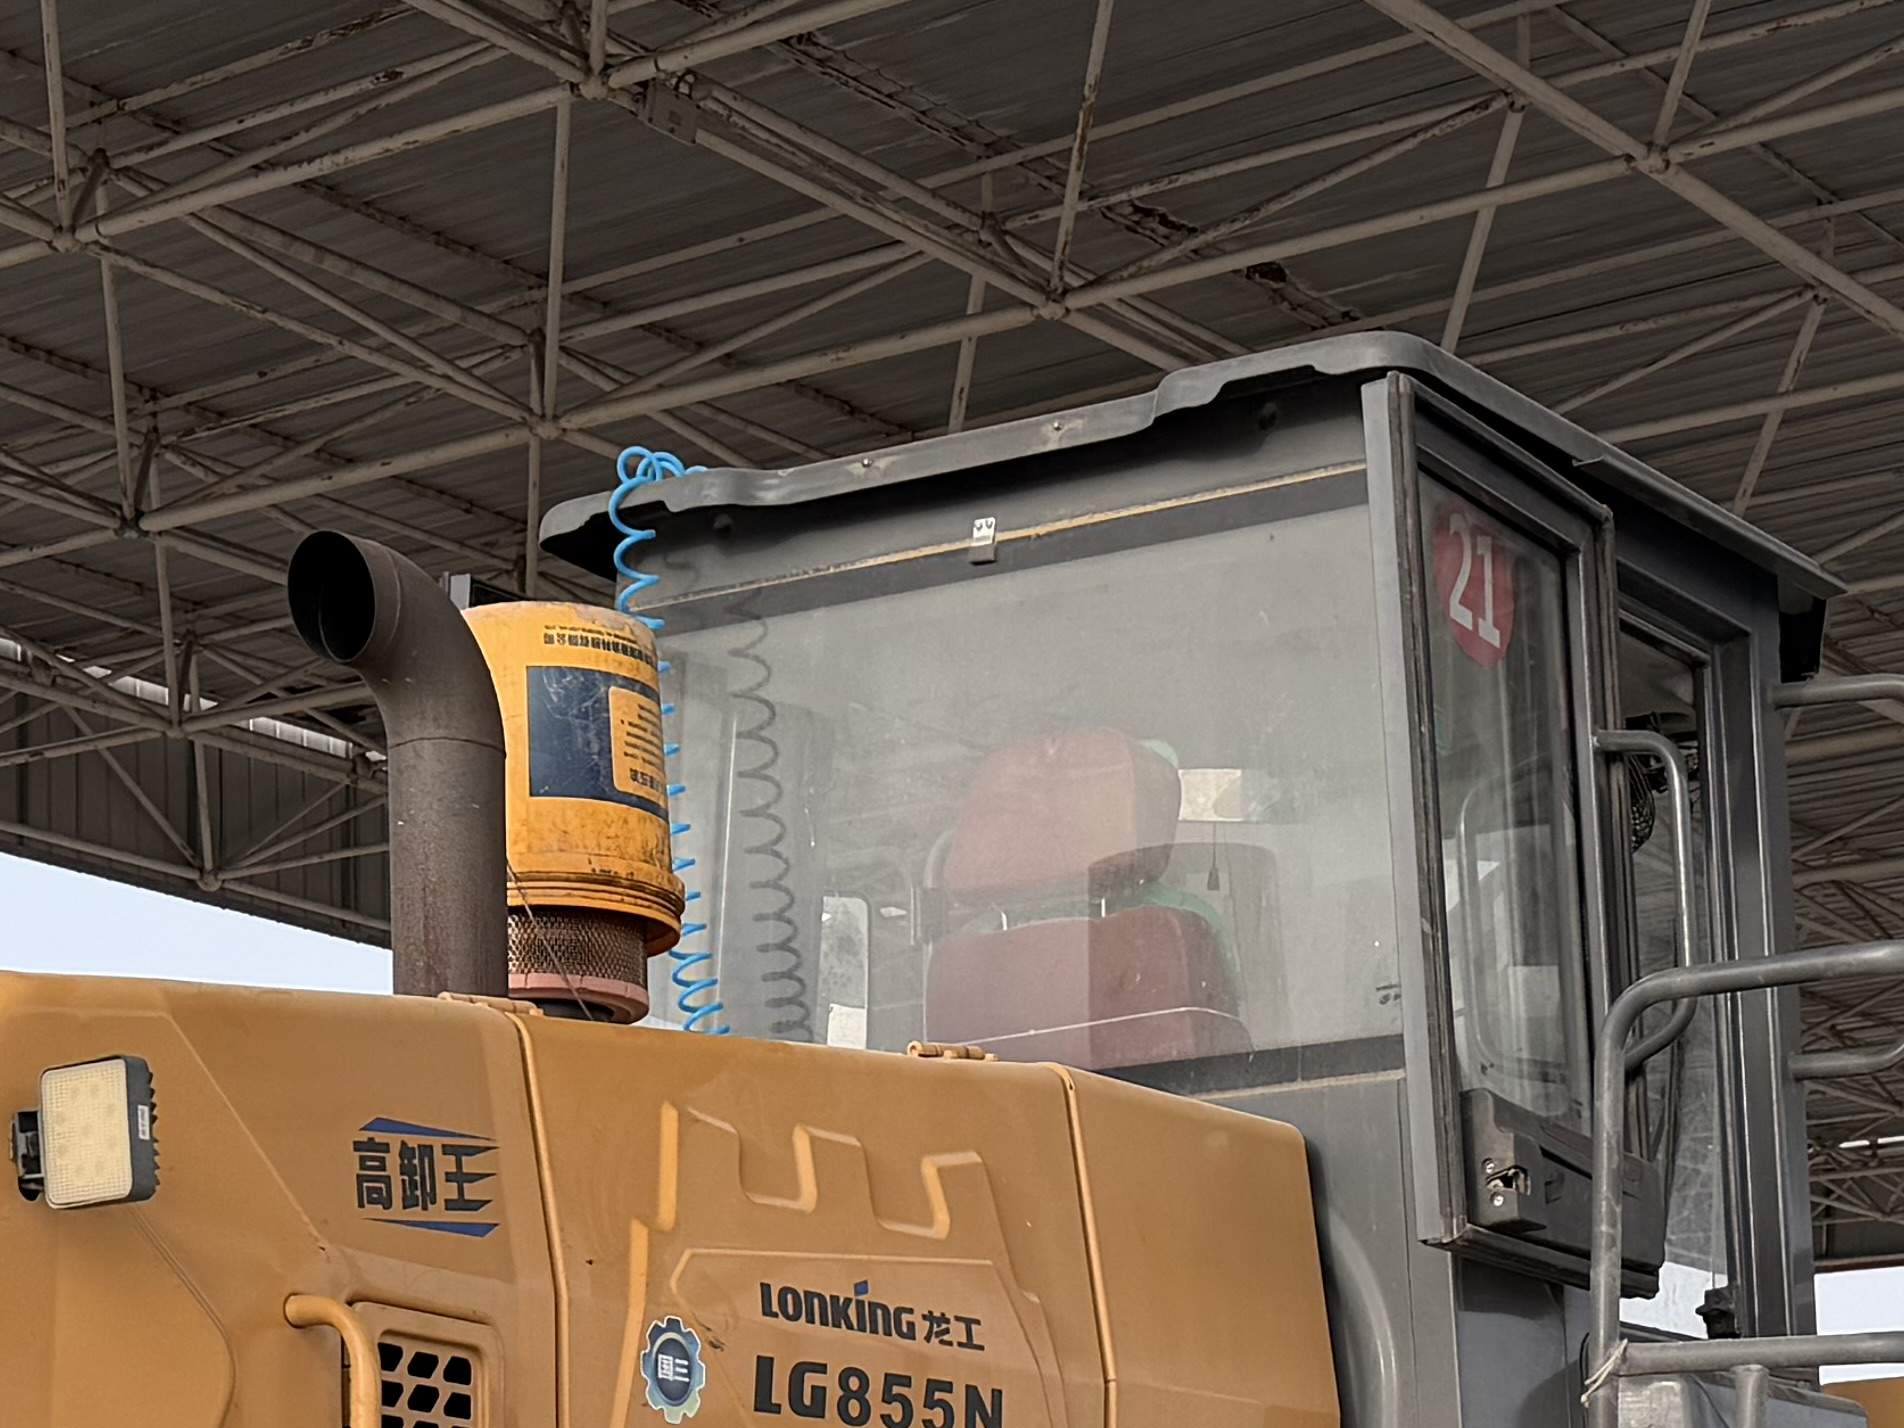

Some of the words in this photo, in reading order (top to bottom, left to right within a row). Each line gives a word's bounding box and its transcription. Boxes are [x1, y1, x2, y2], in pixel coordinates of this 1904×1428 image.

[1449, 513, 1501, 649] 21
[352, 1136, 500, 1212] 高卸王
[921, 1309, 985, 1351] 龙工
